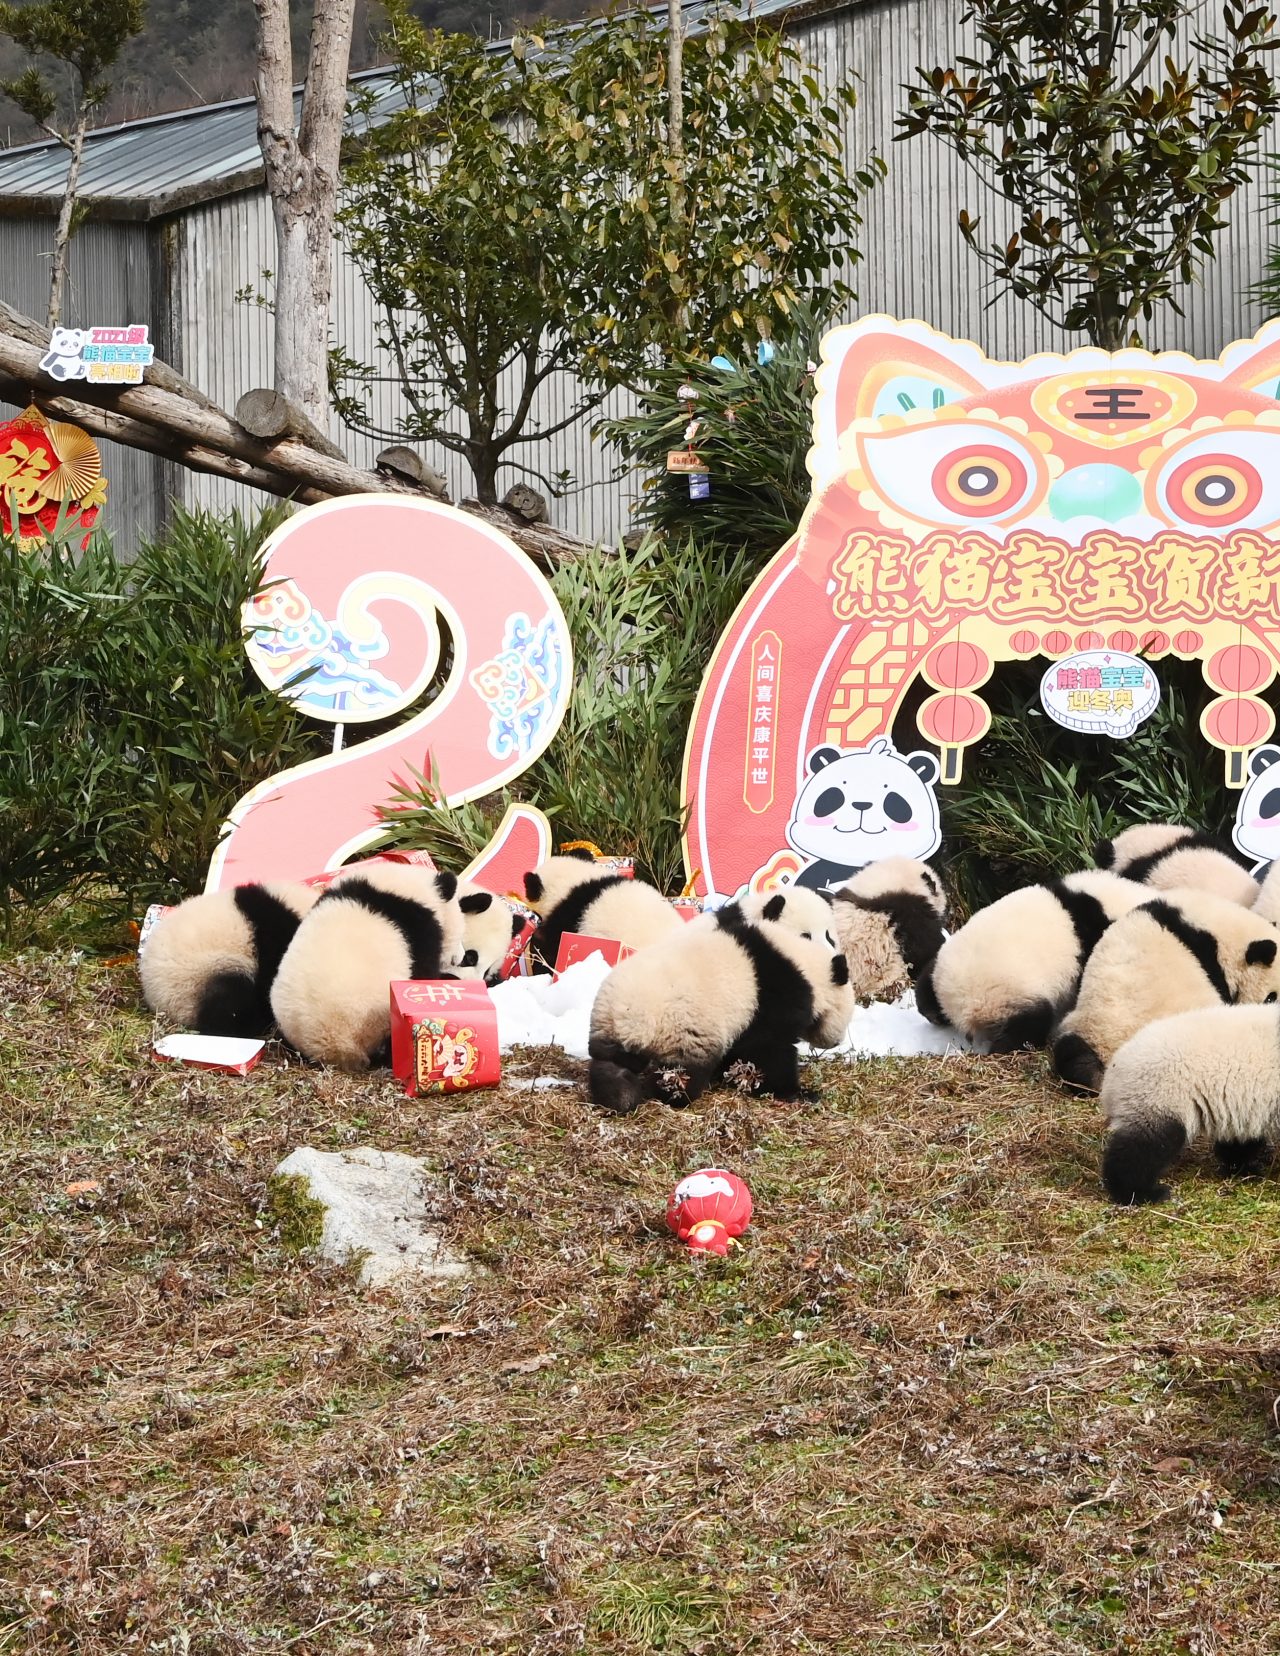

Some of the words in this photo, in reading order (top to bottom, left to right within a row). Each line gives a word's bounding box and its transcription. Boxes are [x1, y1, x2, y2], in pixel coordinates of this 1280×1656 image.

[83, 345, 151, 363] 熊猫宝宝
[1074, 388, 1151, 420] 王
[1057, 667, 1145, 690] 熊猫宝宝
[751, 644, 775, 784] 人间喜庆康平世
[1067, 689, 1134, 716] 迎冬奥
